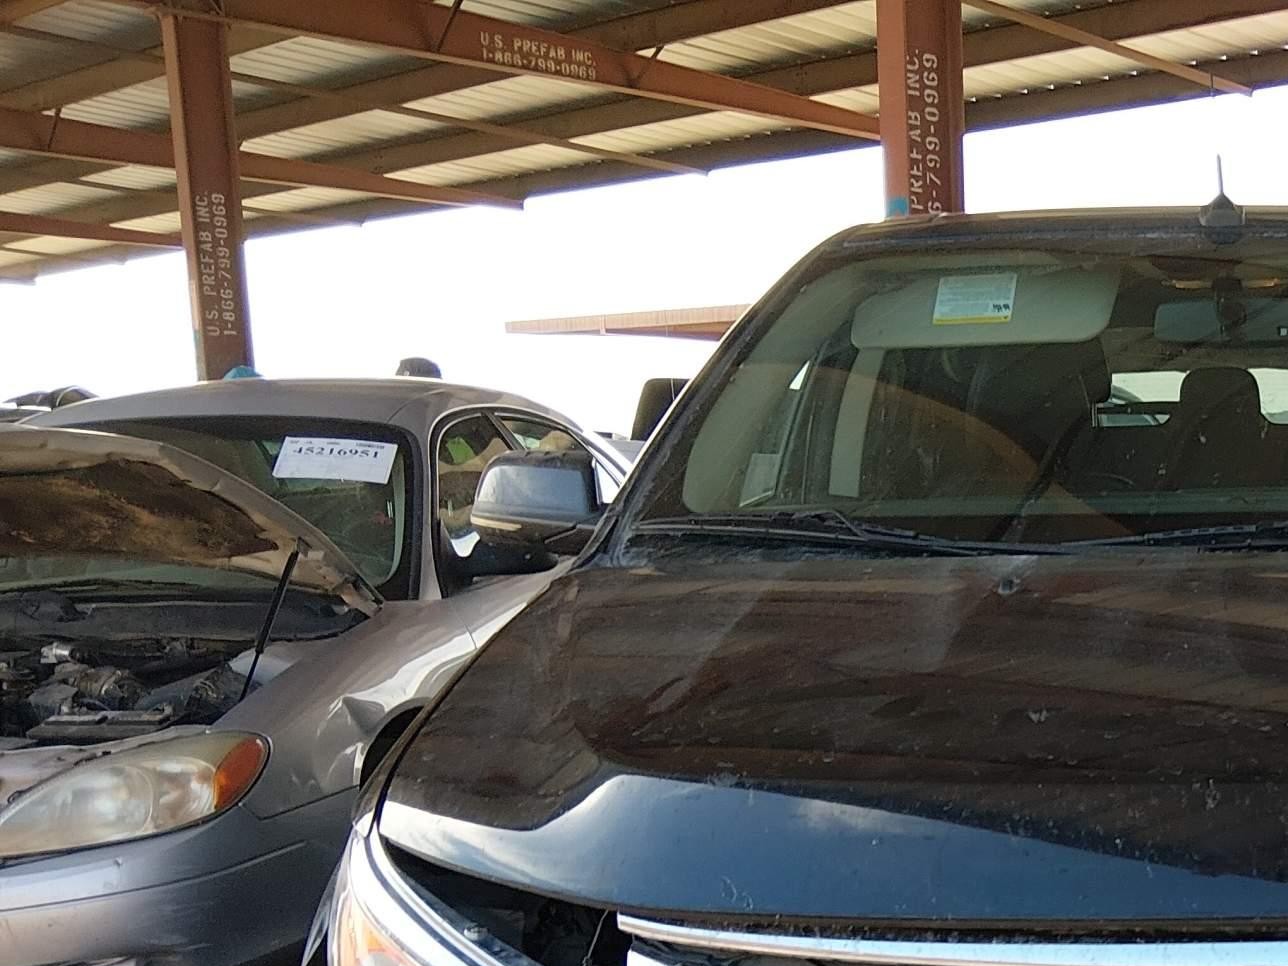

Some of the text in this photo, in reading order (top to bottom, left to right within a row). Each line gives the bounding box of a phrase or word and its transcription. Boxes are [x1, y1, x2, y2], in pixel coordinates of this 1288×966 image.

[480, 32, 597, 66] U.S. PREFAB INC.
[482, 48, 596, 80] 1-866-799-0969
[906, 49, 924, 210] PREFAB INC.
[195, 191, 220, 337] U.S. PREFAB INC.
[211, 193, 237, 335] 1-866-799-0969
[293, 446, 379, 459] 45216951
